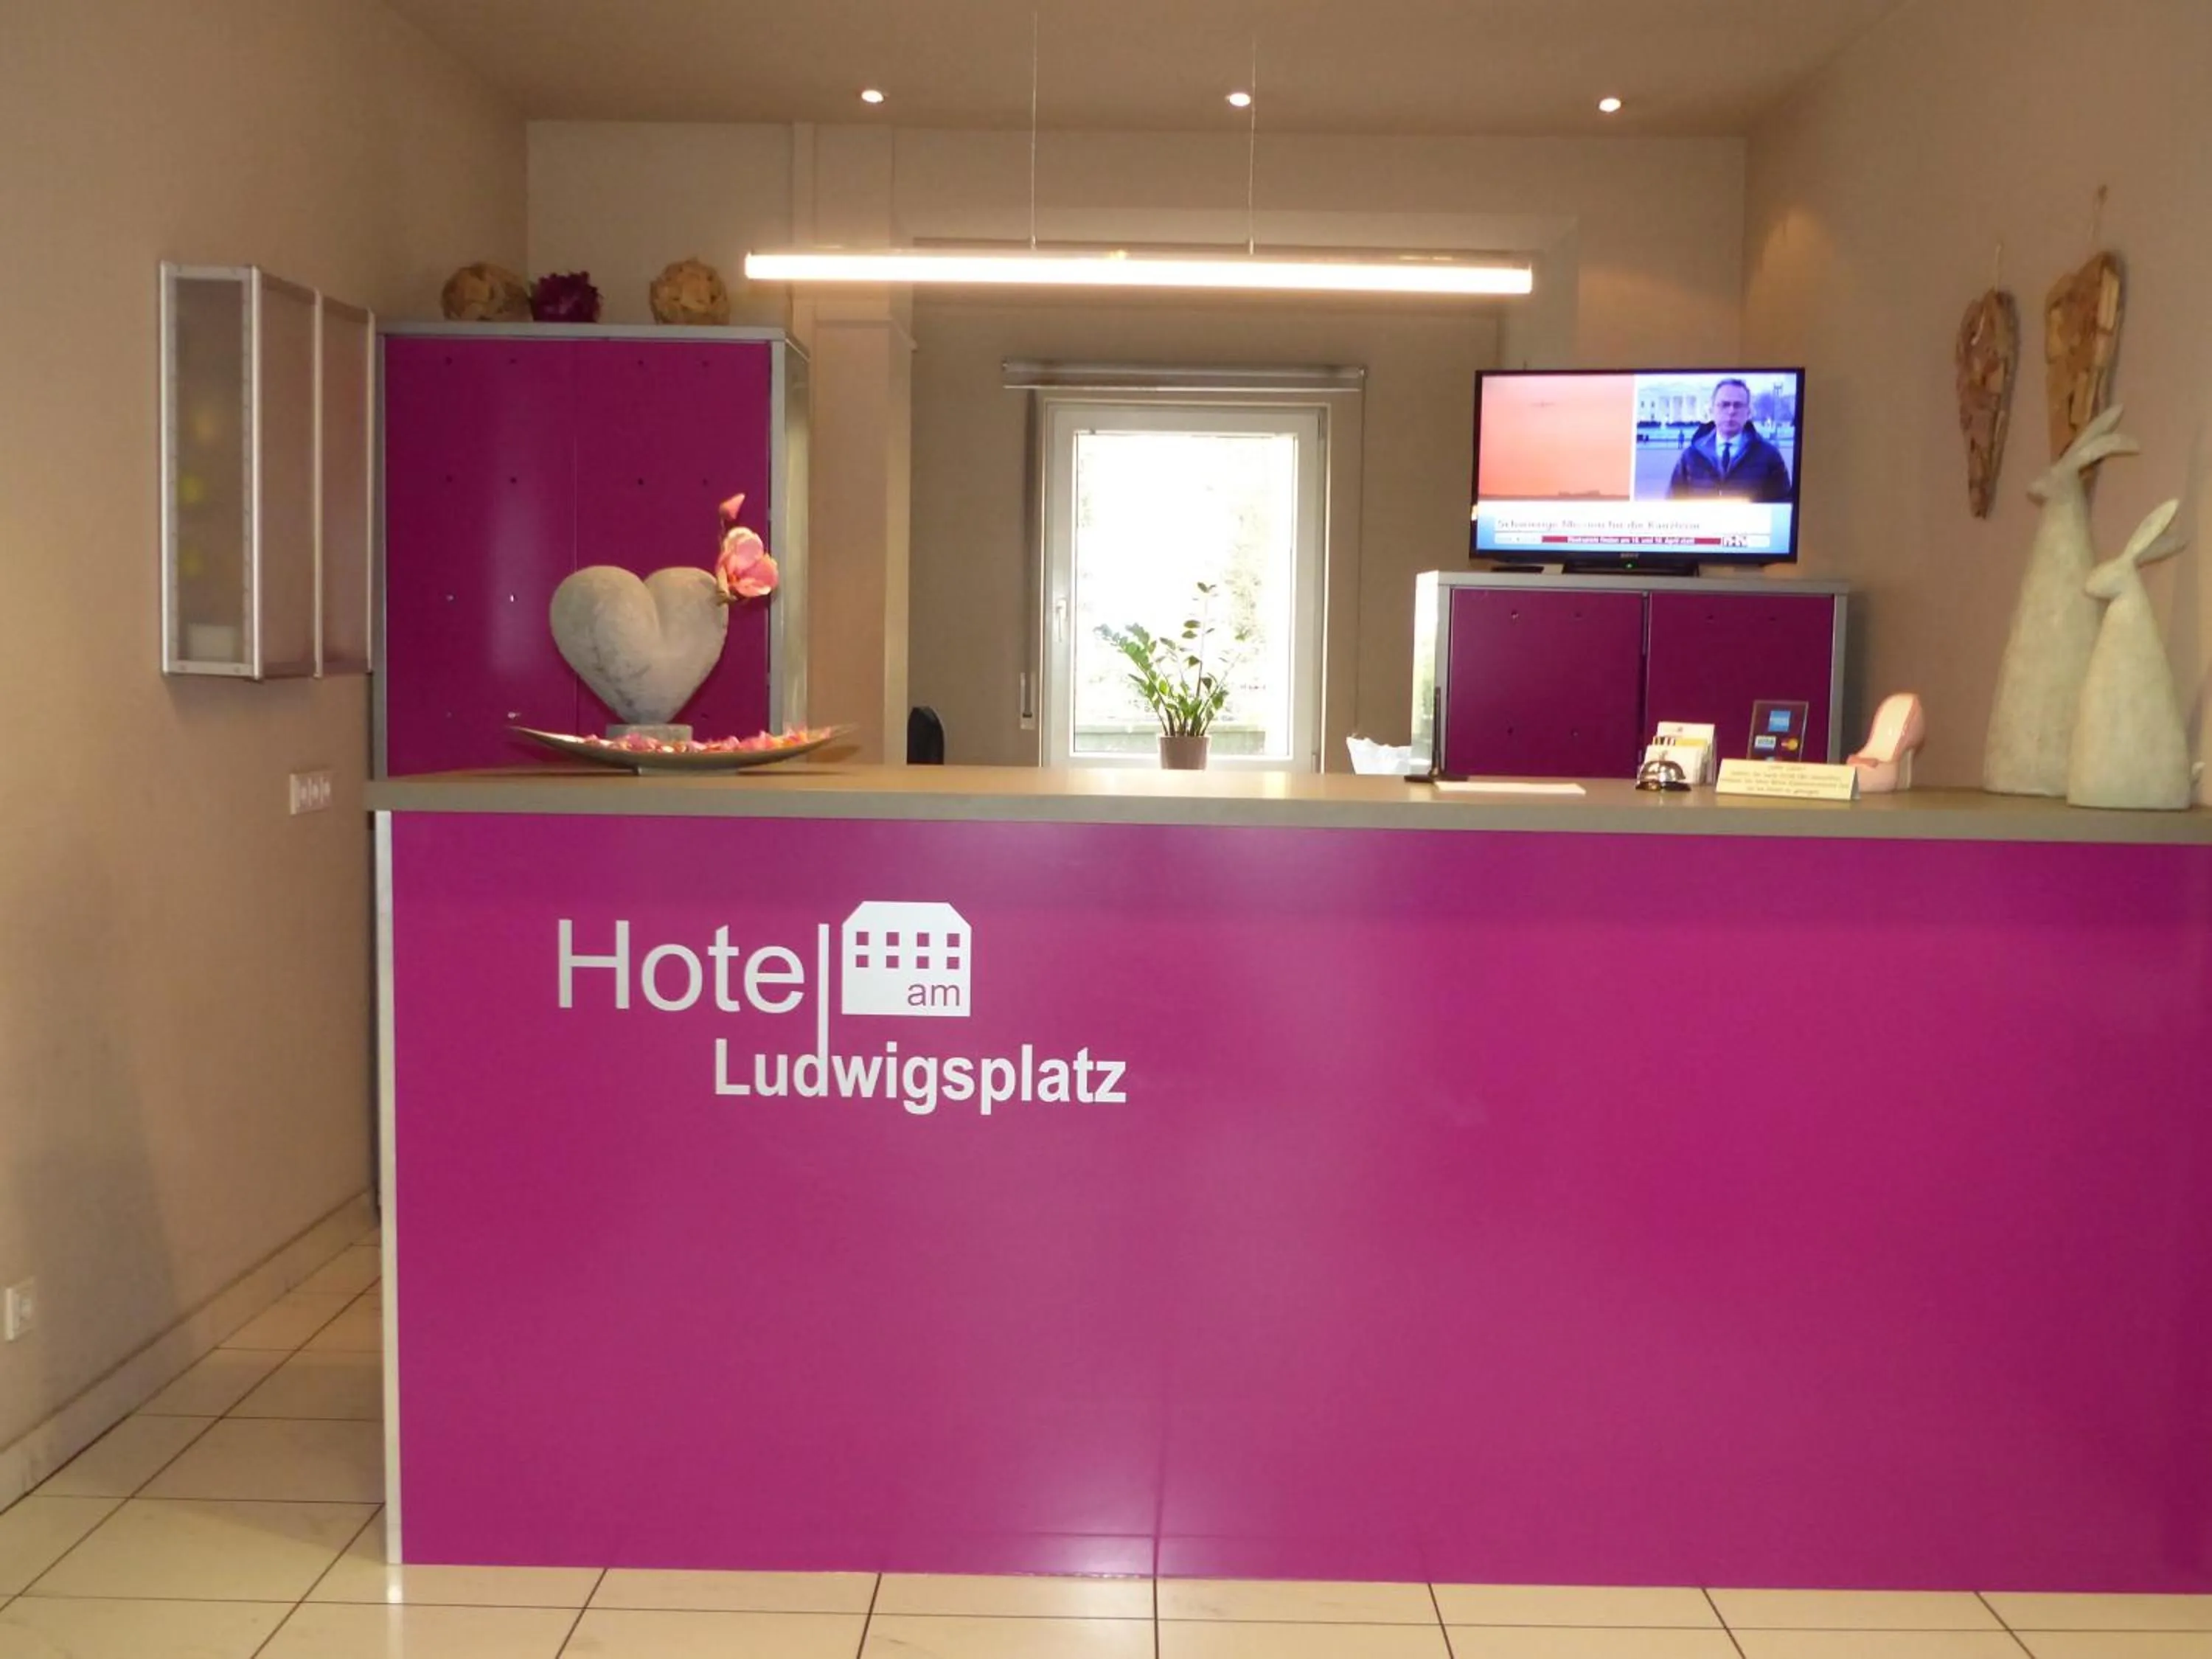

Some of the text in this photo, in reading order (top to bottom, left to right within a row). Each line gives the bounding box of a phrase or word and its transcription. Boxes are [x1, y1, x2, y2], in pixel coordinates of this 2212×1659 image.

[558, 919, 830, 1032] Hotel
[907, 982, 961, 1007] am
[714, 1037, 1127, 1116] Ludwigsplatz
